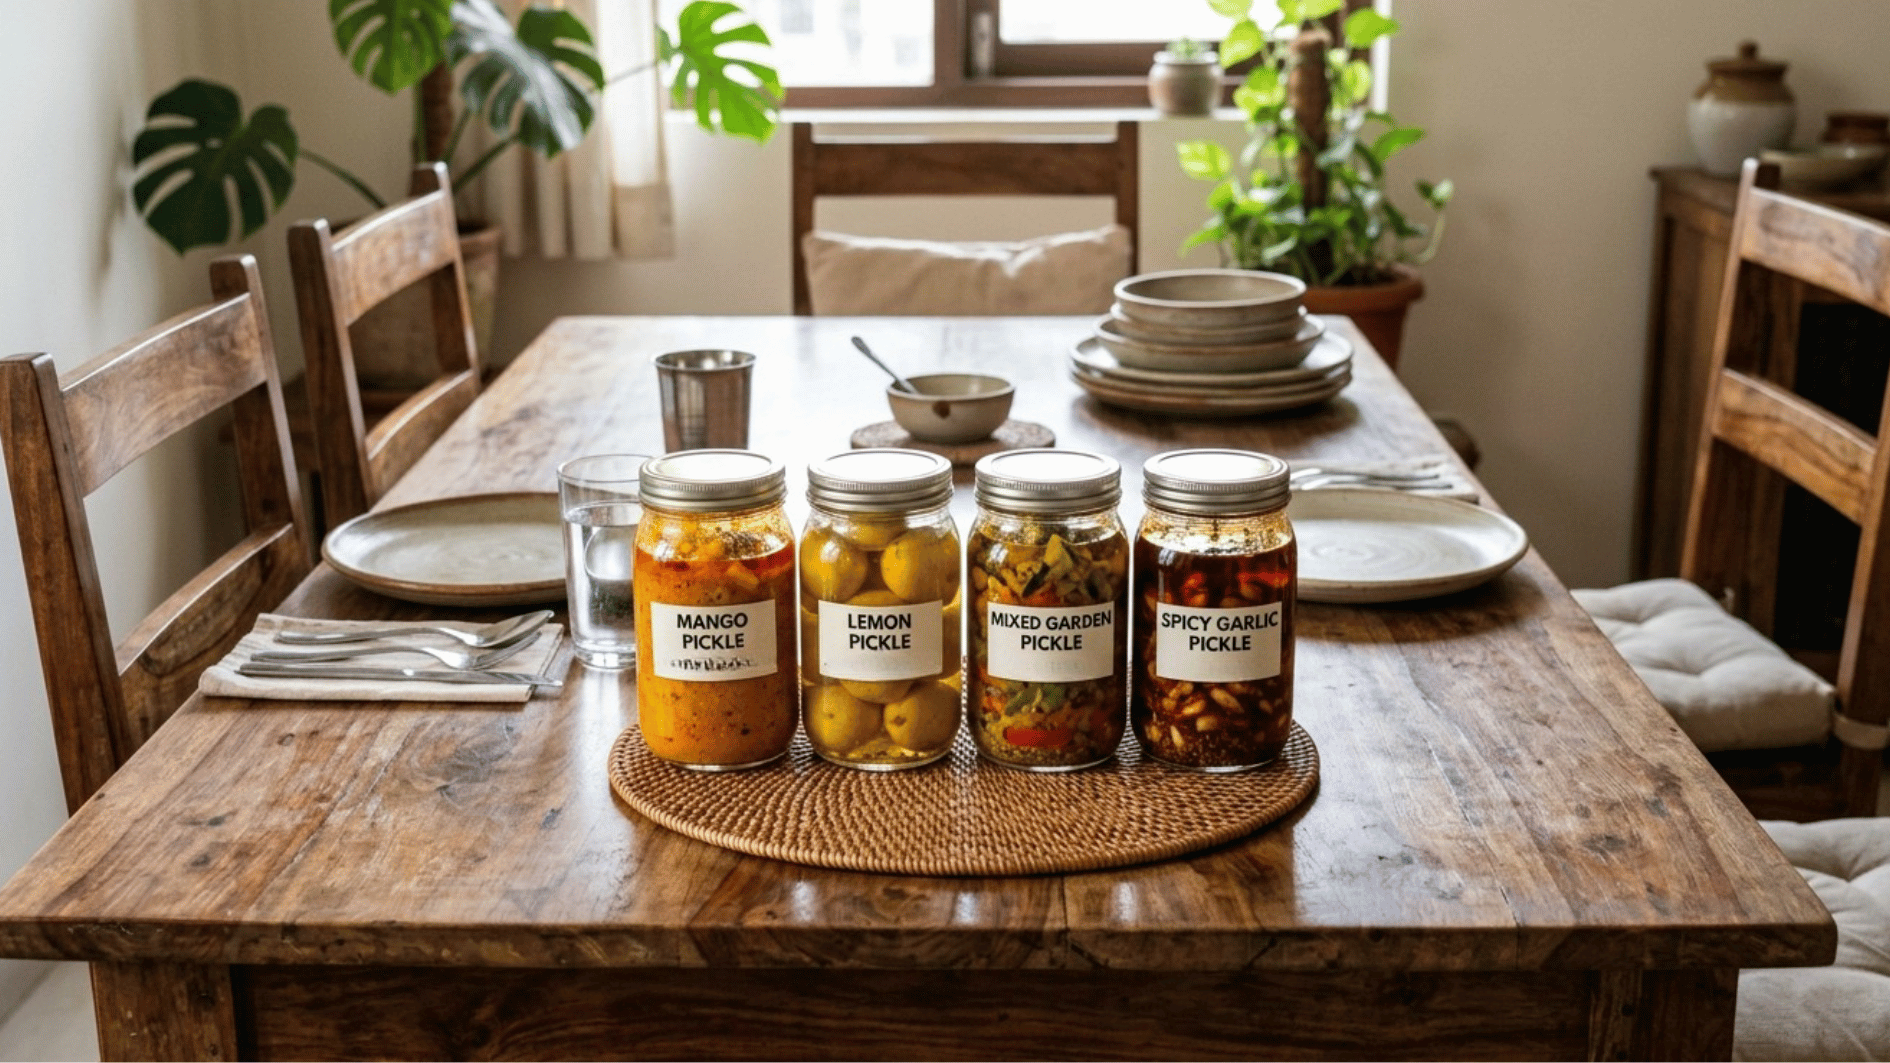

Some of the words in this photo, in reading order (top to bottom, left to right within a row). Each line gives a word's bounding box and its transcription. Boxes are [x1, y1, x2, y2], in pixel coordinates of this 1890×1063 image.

[677, 612, 748, 629] MANGO
[848, 613, 912, 630] LEMON
[991, 611, 1041, 630] MIXED
[1045, 611, 1112, 630] GARDEN
[1161, 612, 1211, 631] SPICY
[1216, 611, 1279, 631] GARLIC
[683, 633, 744, 650] PICKLE
[849, 634, 911, 650] PICKLE
[1021, 634, 1082, 651] PICKLE
[1189, 635, 1251, 651] PICKLE
